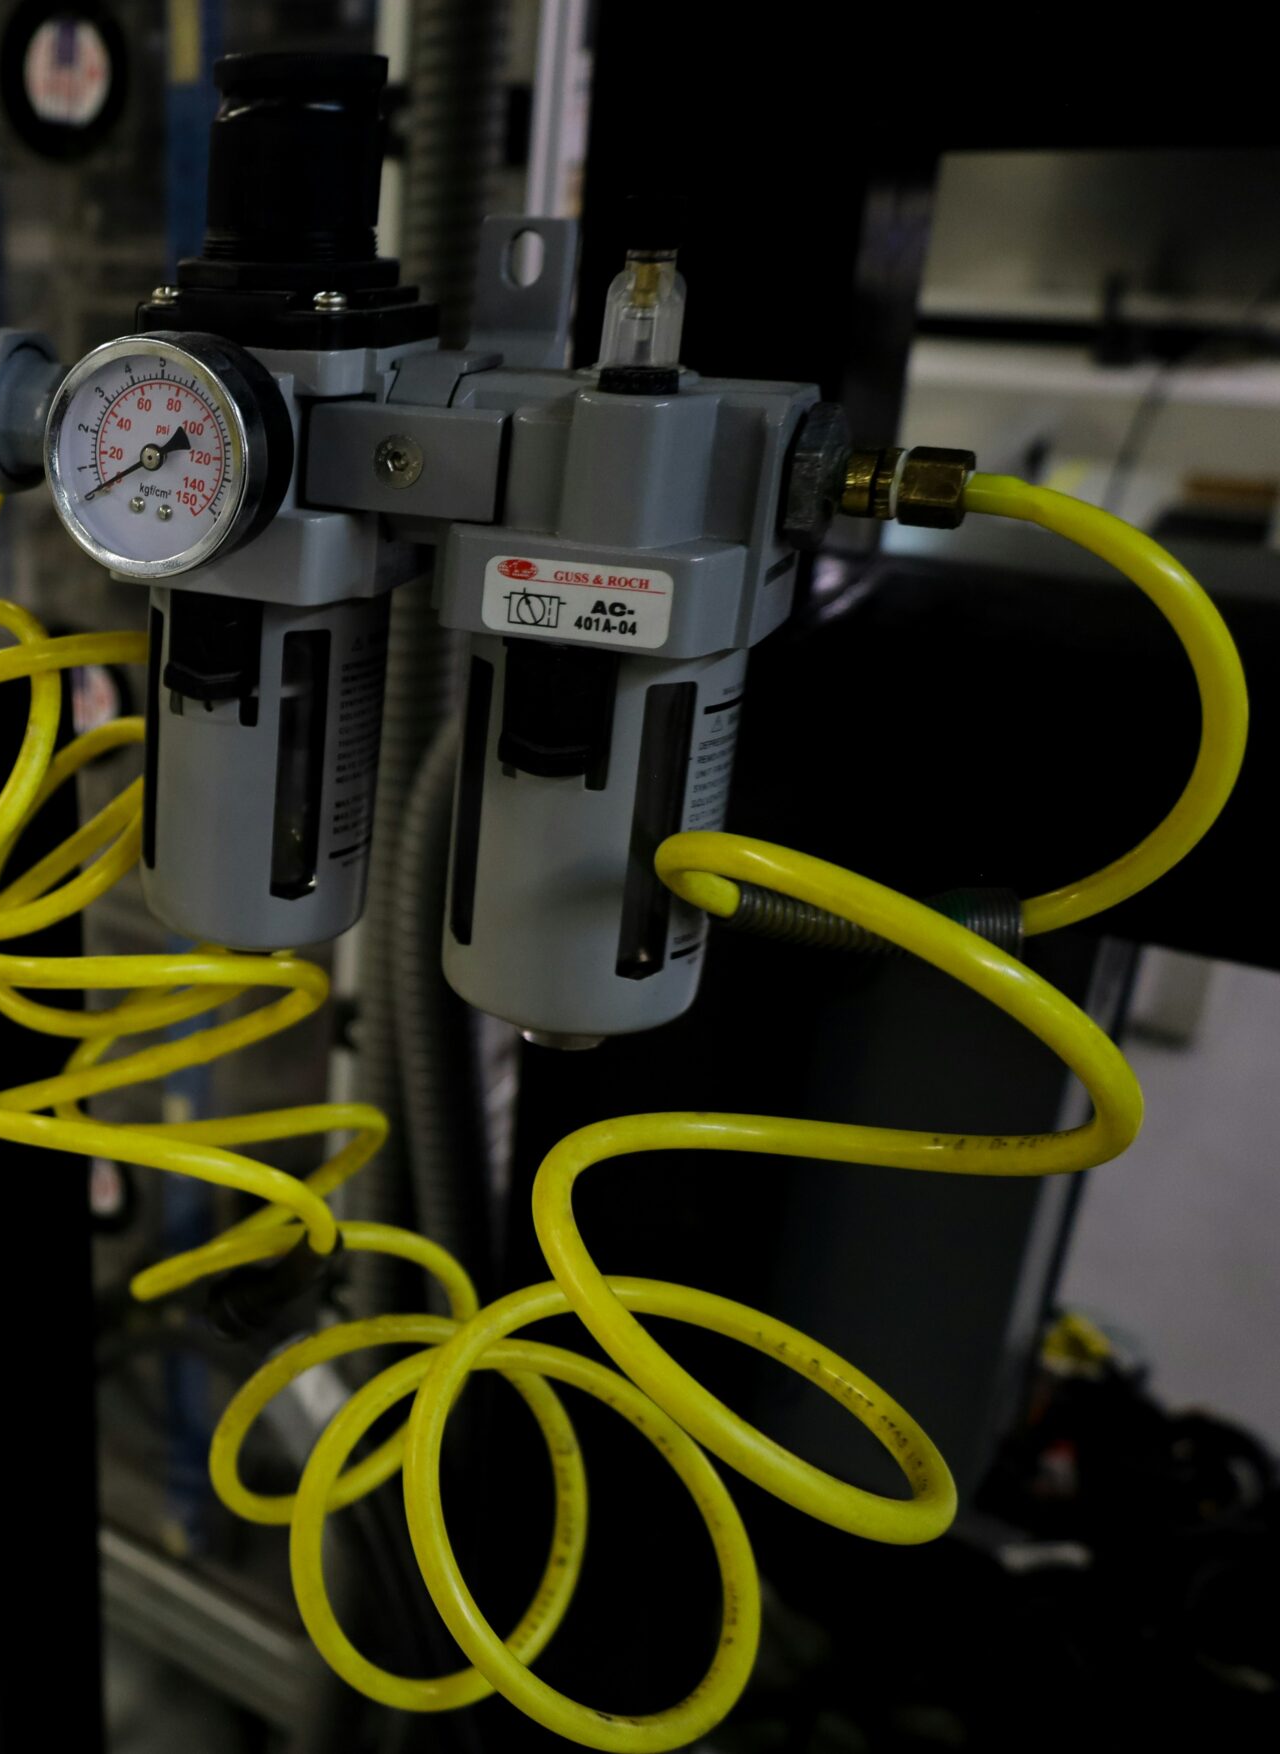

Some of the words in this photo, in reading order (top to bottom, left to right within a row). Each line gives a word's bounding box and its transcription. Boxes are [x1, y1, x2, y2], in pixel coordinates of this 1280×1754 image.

[125, 362, 133, 374] 4
[159, 357, 167, 368] 5
[95, 386, 105, 398] 3
[137, 397, 152, 412] 60
[166, 398, 182, 413] 80
[78, 423, 89, 434] 2
[116, 417, 132, 432] 40
[156, 424, 170, 436] psi
[183, 419, 204, 436] 100
[109, 446, 124, 461] 20
[189, 449, 211, 466] 120
[77, 465, 88, 473] 1
[183, 476, 205, 493] 140
[176, 490, 197, 506] 150
[553, 570, 590, 584] GUSS
[592, 574, 603, 585] &
[607, 575, 651, 590] ROCH
[590, 600, 635, 617] AC-
[574, 615, 637, 636] 401A-04
